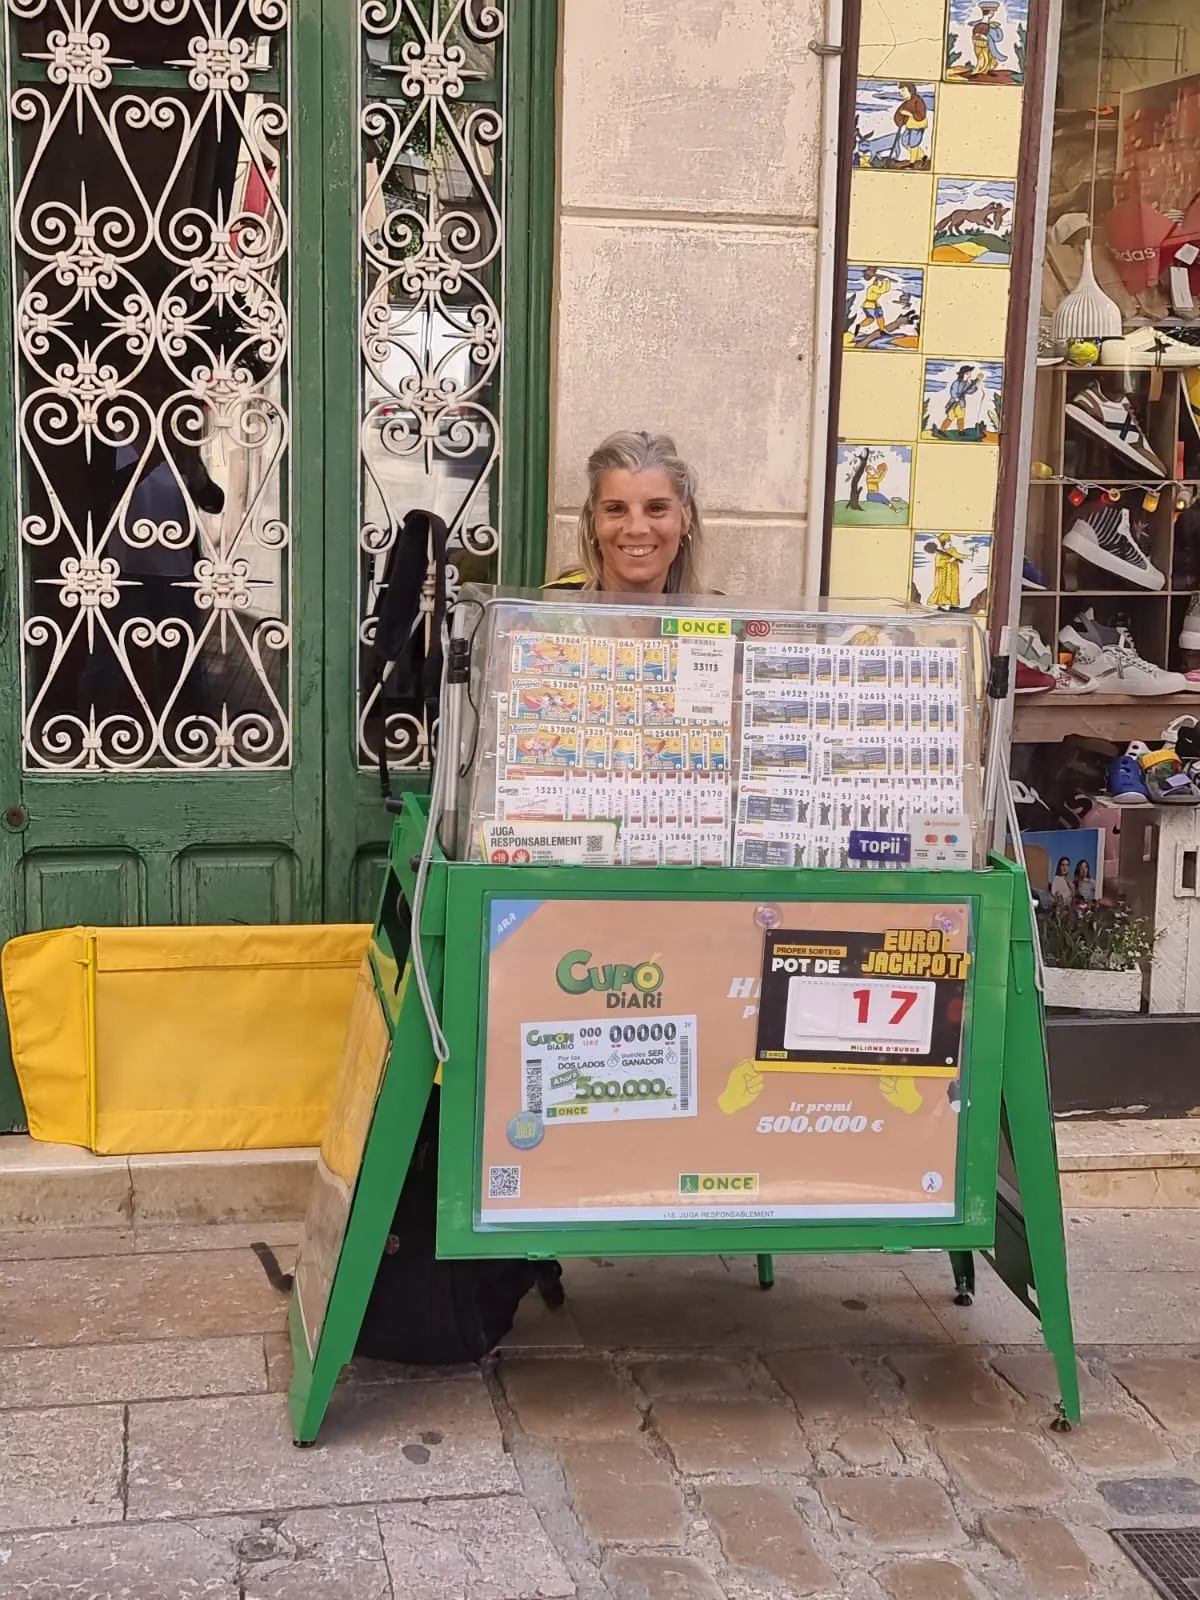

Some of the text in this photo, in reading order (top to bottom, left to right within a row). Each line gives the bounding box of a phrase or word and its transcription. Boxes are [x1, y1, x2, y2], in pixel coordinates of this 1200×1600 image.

[682, 621, 726, 634] ONCE
[693, 662, 719, 672] 33113
[490, 826, 515, 836] JUGA
[490, 836, 583, 848] RESPONSABLEMENT
[496, 912, 517, 936] ARA
[883, 929, 941, 953] EURO
[776, 947, 841, 956] PROPER SORTEIG
[771, 957, 841, 974] POT DE
[860, 951, 962, 977] JACKPOT
[579, 1027, 602, 1038] 000
[609, 1022, 677, 1043] 00000
[621, 1049, 664, 1059] puedes SER
[558, 1061, 606, 1070] DOS LADOS
[622, 1058, 664, 1067] GANADOR
[553, 1071, 578, 1085] Ahora
[558, 1106, 588, 1115] ONCE
[806, 1100, 853, 1114] premi
[756, 1115, 884, 1133] 500.000 €
[703, 1177, 754, 1190] ONCE
[701, 1210, 775, 1218] RESPONSABLEMENT
